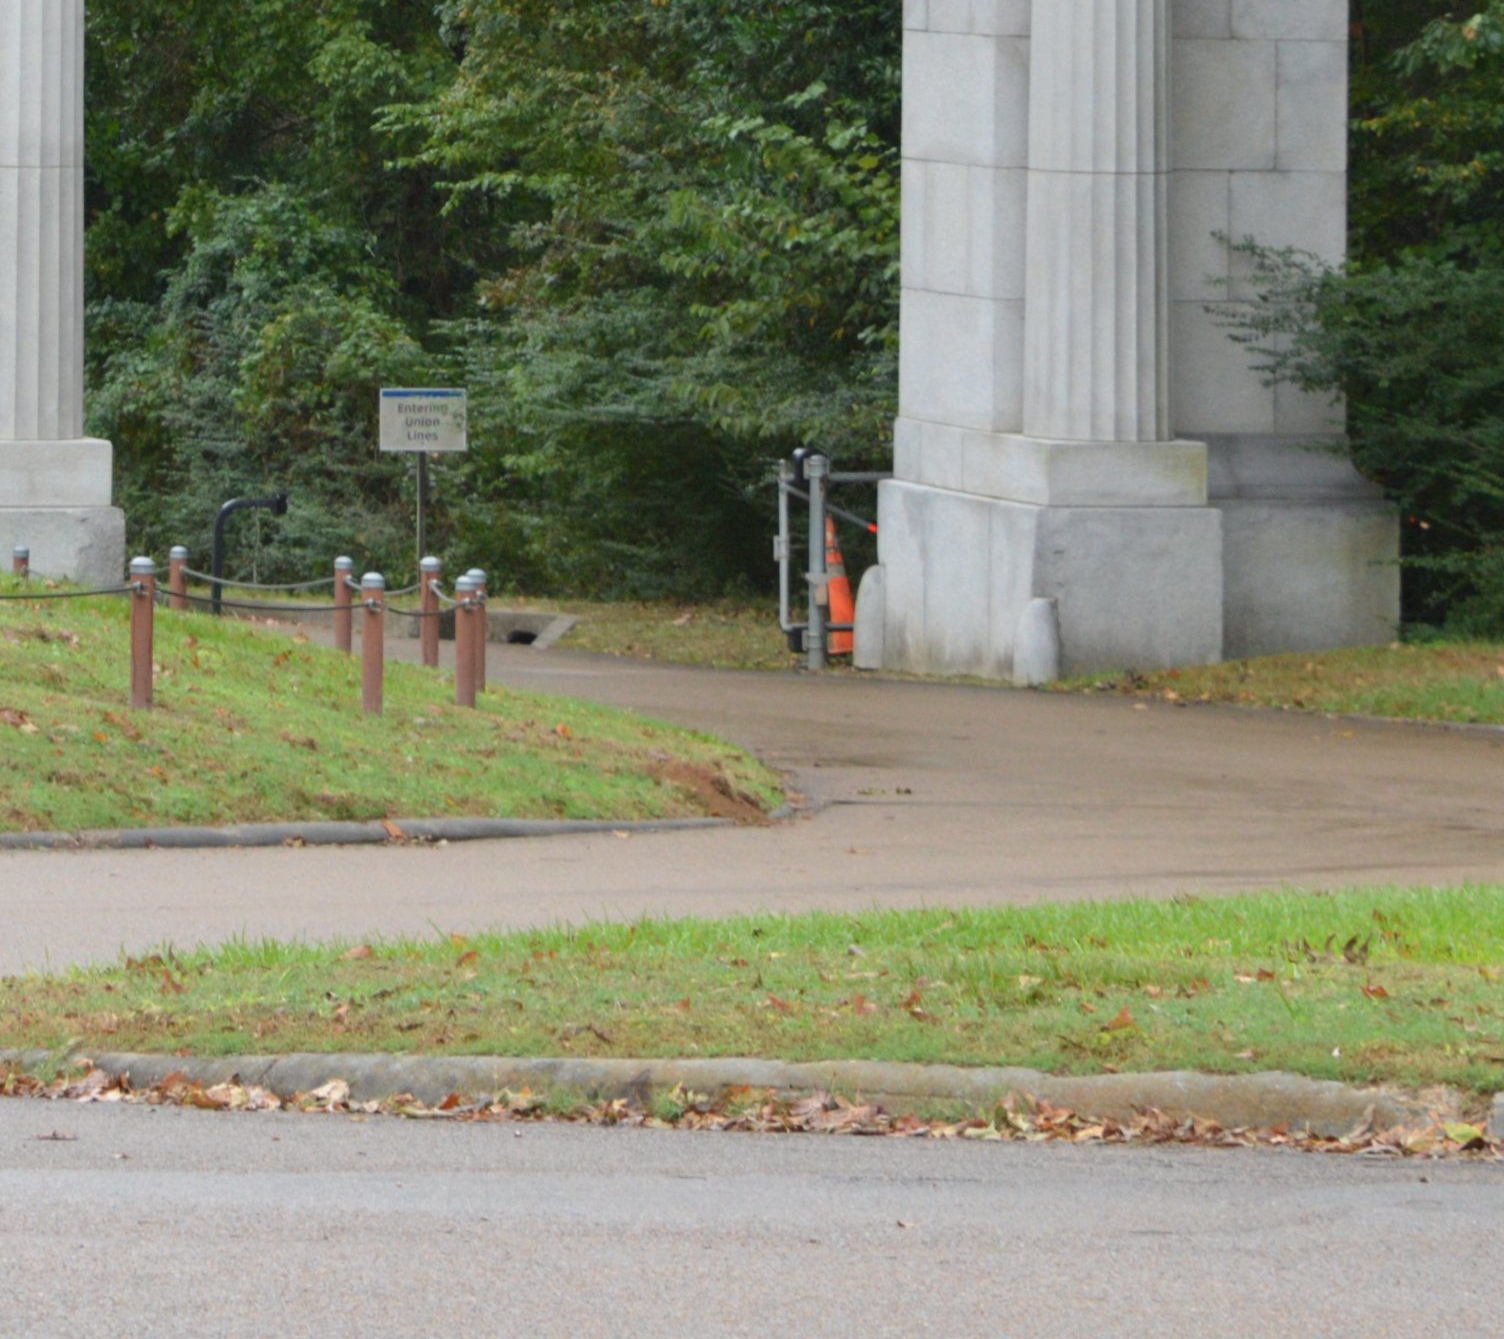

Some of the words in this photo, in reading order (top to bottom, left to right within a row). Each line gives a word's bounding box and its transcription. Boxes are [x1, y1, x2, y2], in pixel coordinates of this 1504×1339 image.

[397, 403, 448, 417] Entering
[405, 416, 441, 427] Union
[407, 430, 438, 441] Lines
